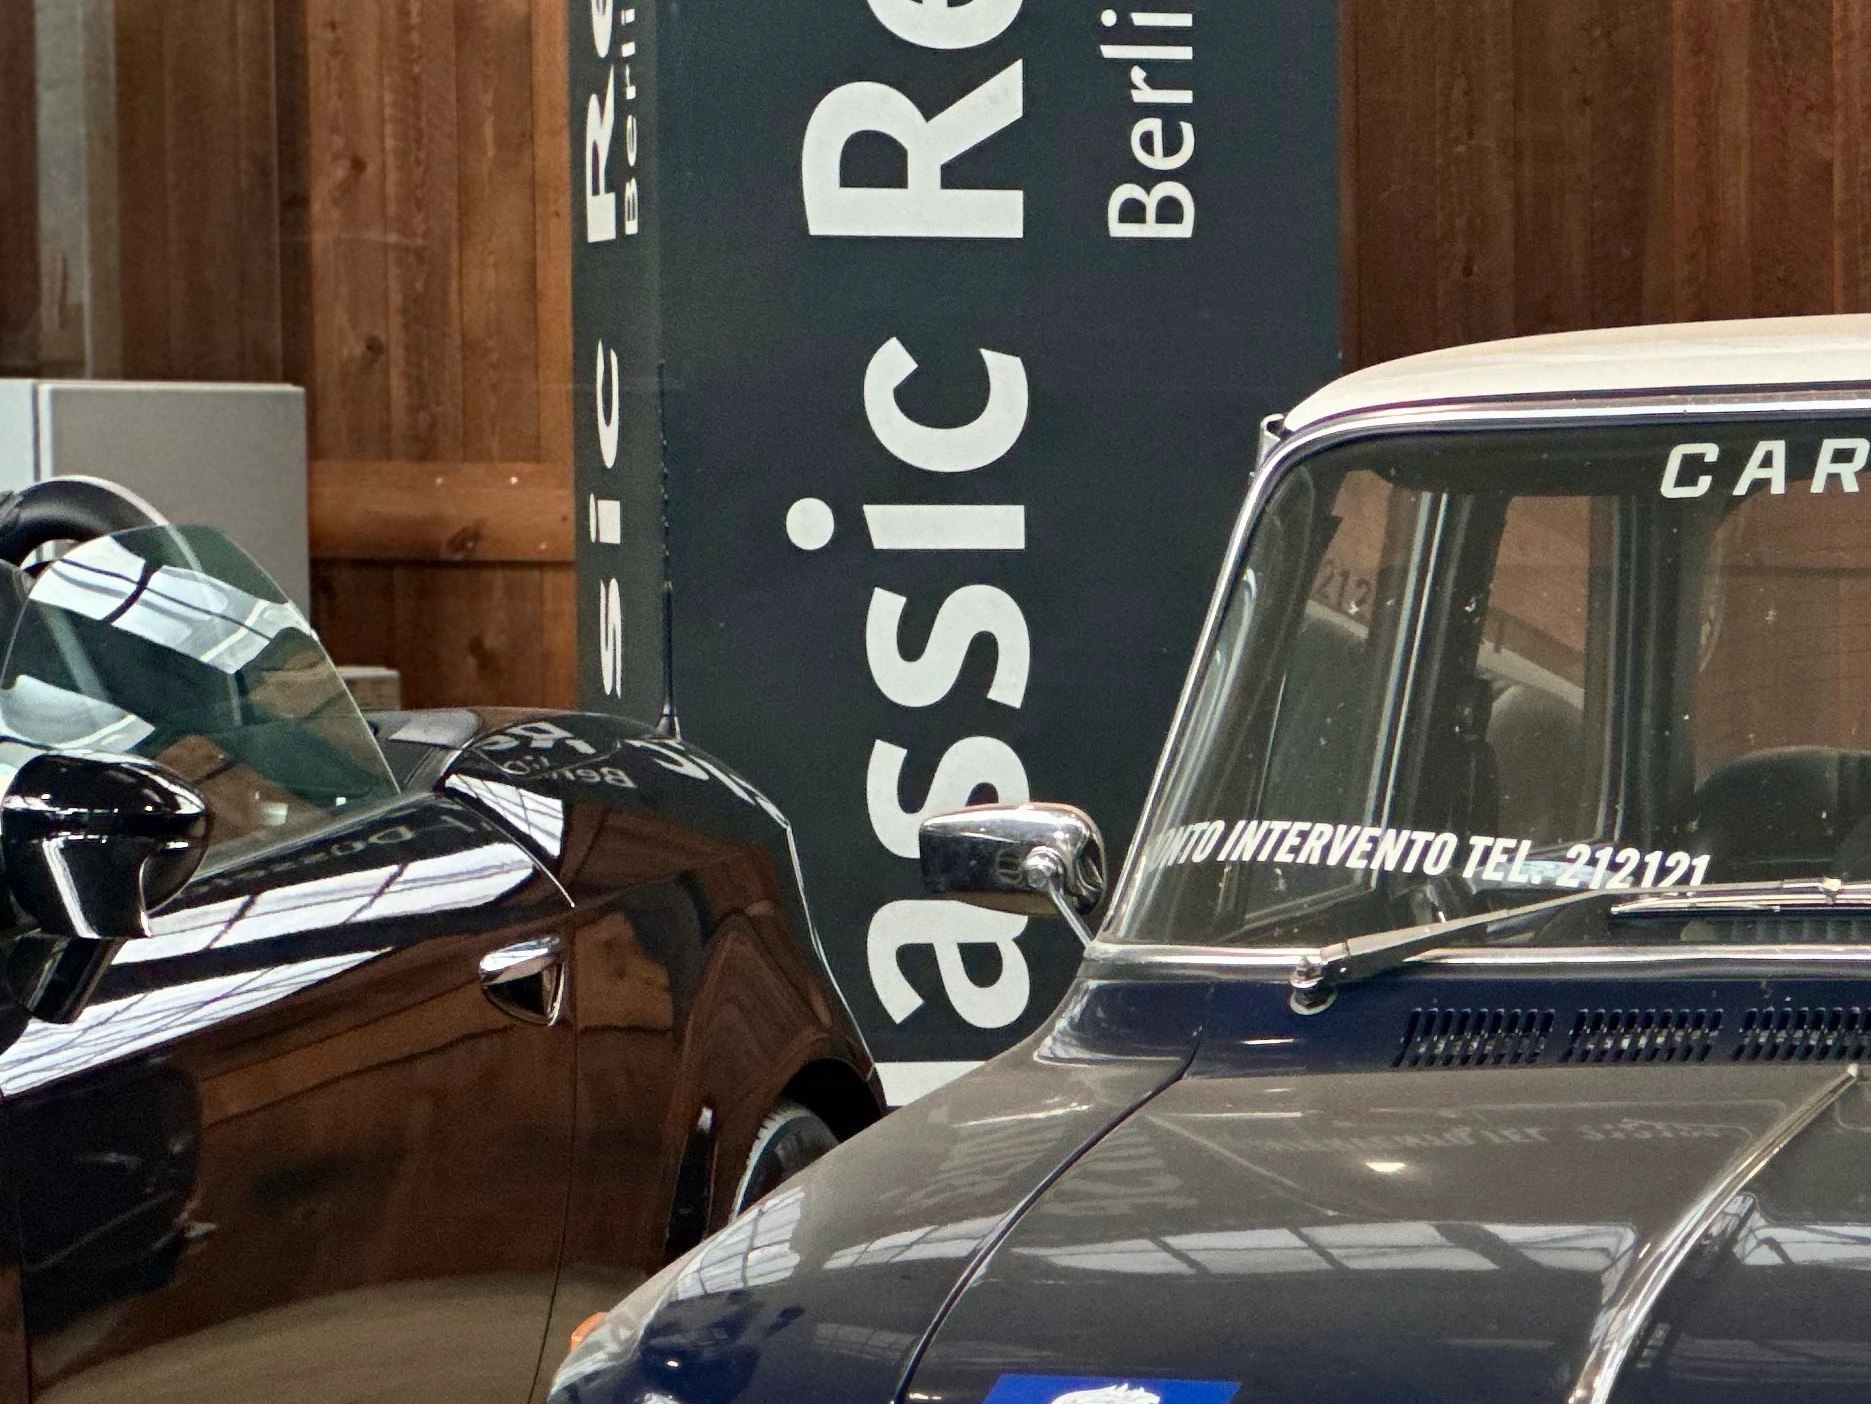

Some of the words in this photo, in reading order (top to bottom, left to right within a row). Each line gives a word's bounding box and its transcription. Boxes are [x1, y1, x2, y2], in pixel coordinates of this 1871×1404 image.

[1100, 8, 1195, 238] Berli
[1217, 818, 1458, 876] INTERVENTO
[1461, 834, 1542, 884] TEL.
[1554, 843, 1712, 889] 212121
